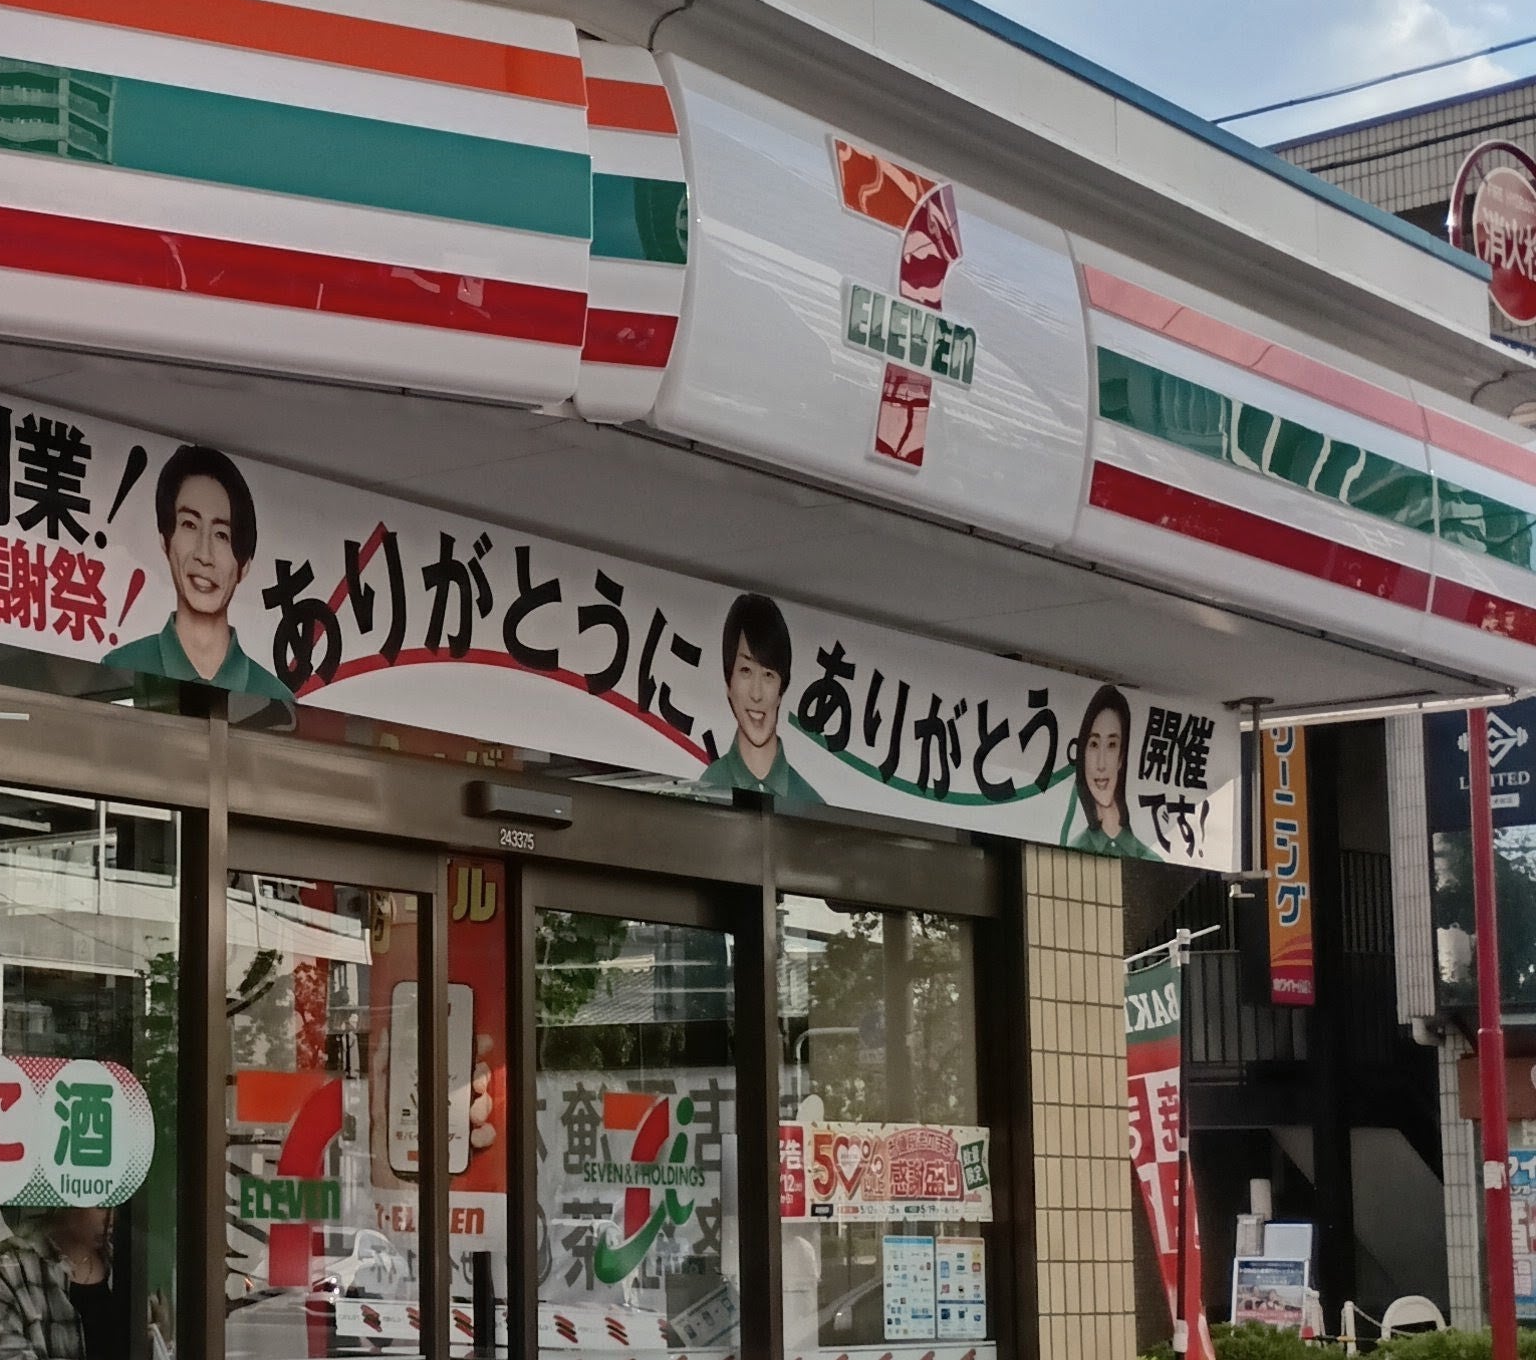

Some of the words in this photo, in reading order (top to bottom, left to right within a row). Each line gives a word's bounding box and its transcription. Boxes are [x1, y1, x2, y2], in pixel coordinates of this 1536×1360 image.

[1139, 706, 1216, 790] 開催
[1459, 771, 1531, 790] LITED
[500, 828, 535, 850] 243375
[1137, 793, 1210, 859] です!
[54, 1080, 114, 1167] 酒
[60, 1173, 114, 1197] liquor
